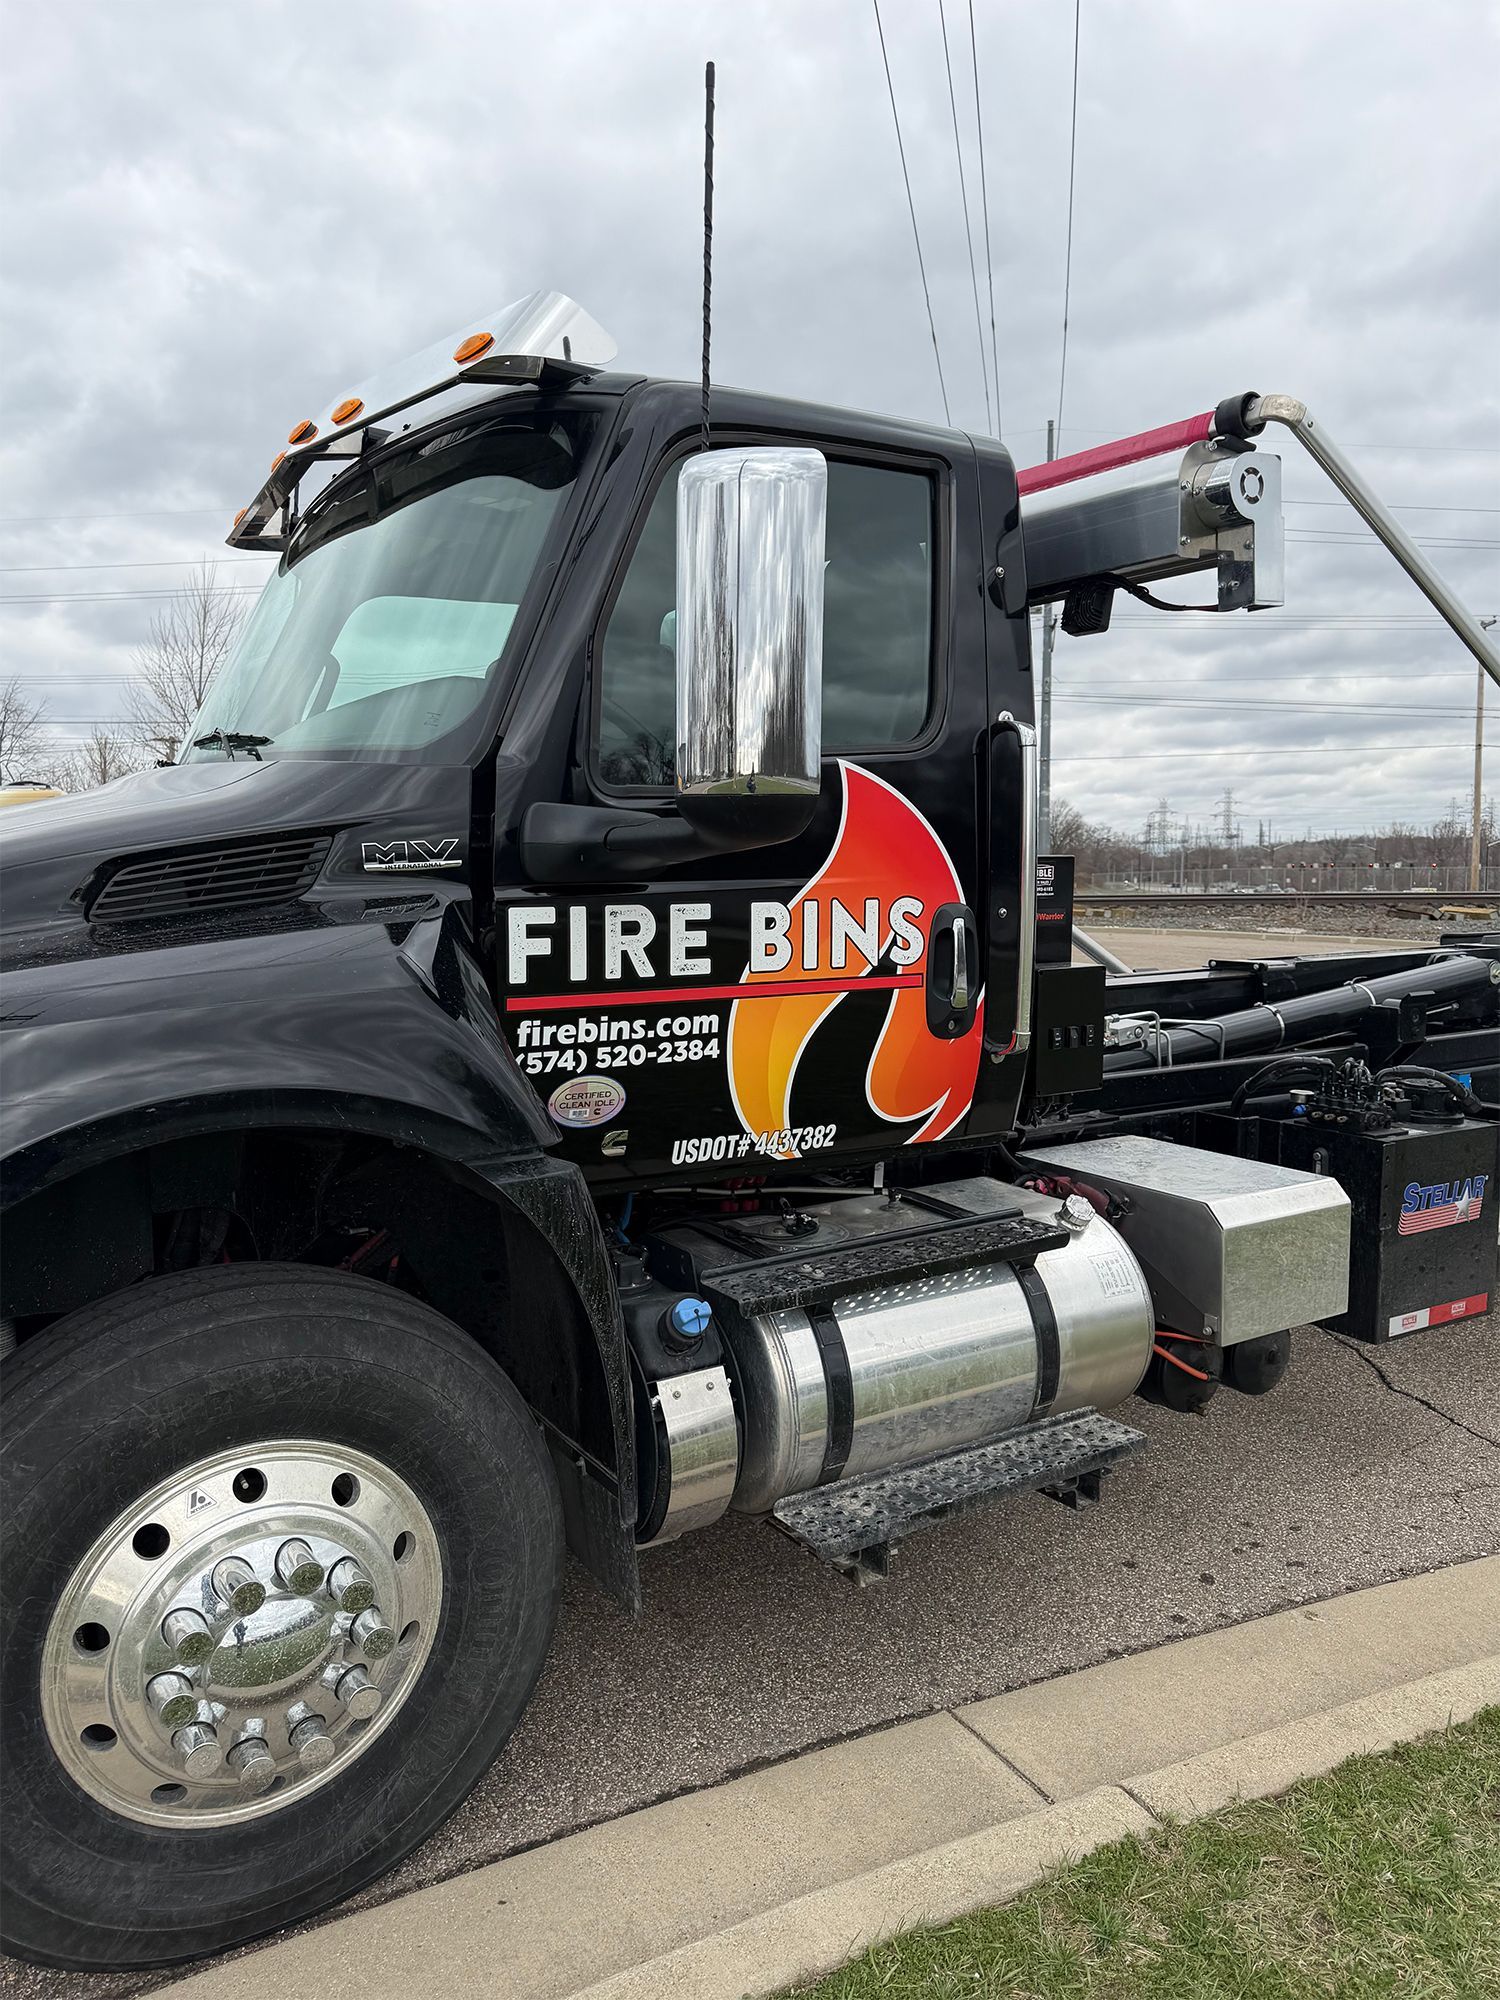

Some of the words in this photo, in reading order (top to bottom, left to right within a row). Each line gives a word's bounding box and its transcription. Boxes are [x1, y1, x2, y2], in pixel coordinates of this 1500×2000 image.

[361, 839, 460, 864] MV
[385, 862, 442, 870] INTERNATIONAL
[508, 903, 711, 984] FIRE
[751, 897, 925, 973] BINS
[517, 1014, 720, 1047] firebins.com
[515, 1049, 588, 1074] (574)
[595, 1038, 720, 1069] 520-2384
[559, 1101, 591, 1110] CLEAN
[595, 1099, 616, 1107] IDLE
[565, 1091, 612, 1101] CERTIFIED
[671, 1133, 751, 1165] USDOT#
[754, 1124, 837, 1155] 4437382
[1401, 1175, 1486, 1214] STELLAR
